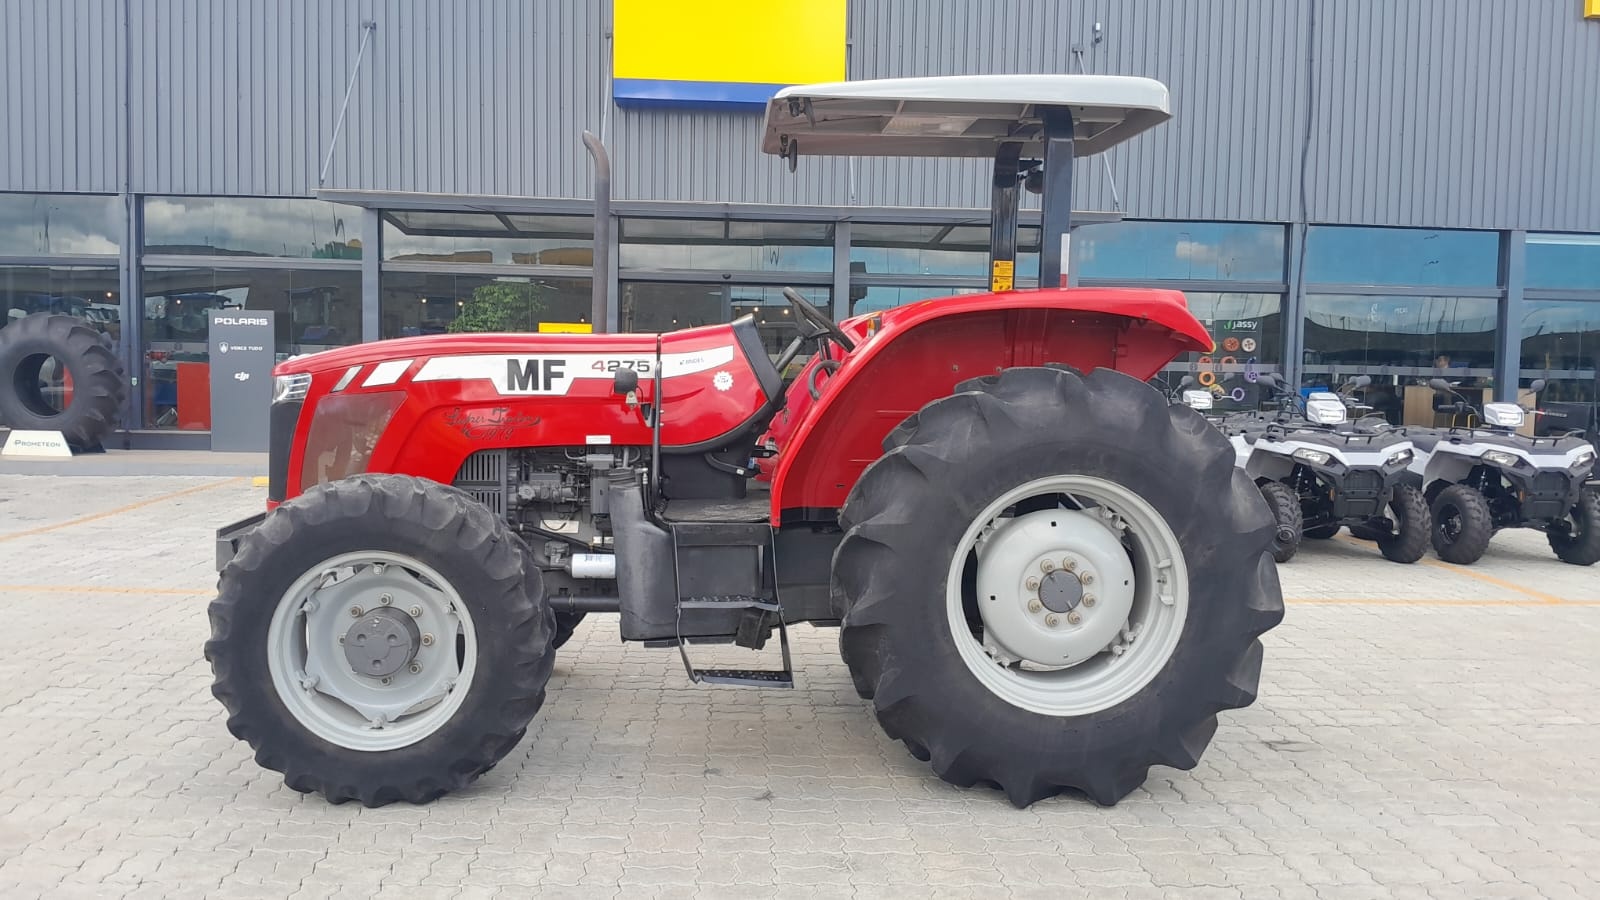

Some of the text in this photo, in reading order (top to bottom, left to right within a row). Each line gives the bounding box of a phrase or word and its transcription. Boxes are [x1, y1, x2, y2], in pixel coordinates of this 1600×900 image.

[214, 317, 268, 326] POLARIS
[507, 358, 651, 391] MF 4275
